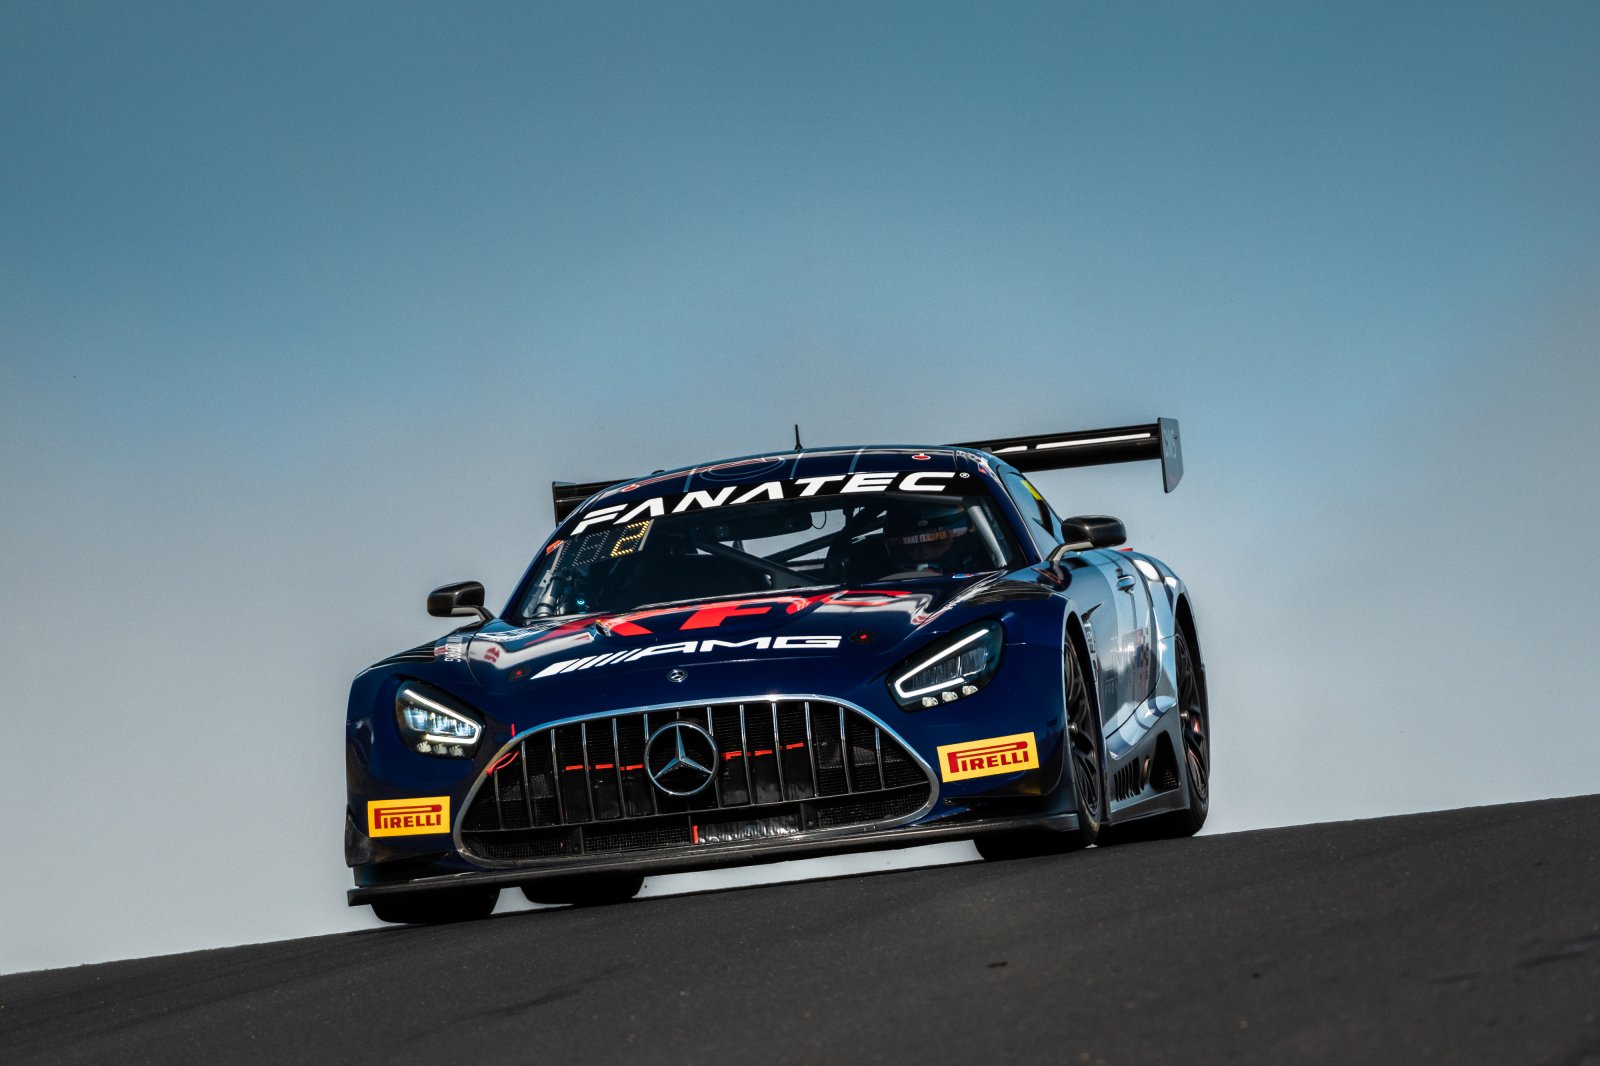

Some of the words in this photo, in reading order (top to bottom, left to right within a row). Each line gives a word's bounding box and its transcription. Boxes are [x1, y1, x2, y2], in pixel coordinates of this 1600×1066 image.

[570, 472, 956, 536] FANATEC
[609, 520, 651, 558] 2
[626, 636, 842, 660] AMG
[947, 741, 1029, 773] PIRELLI
[374, 804, 442, 830] PIRELLI
